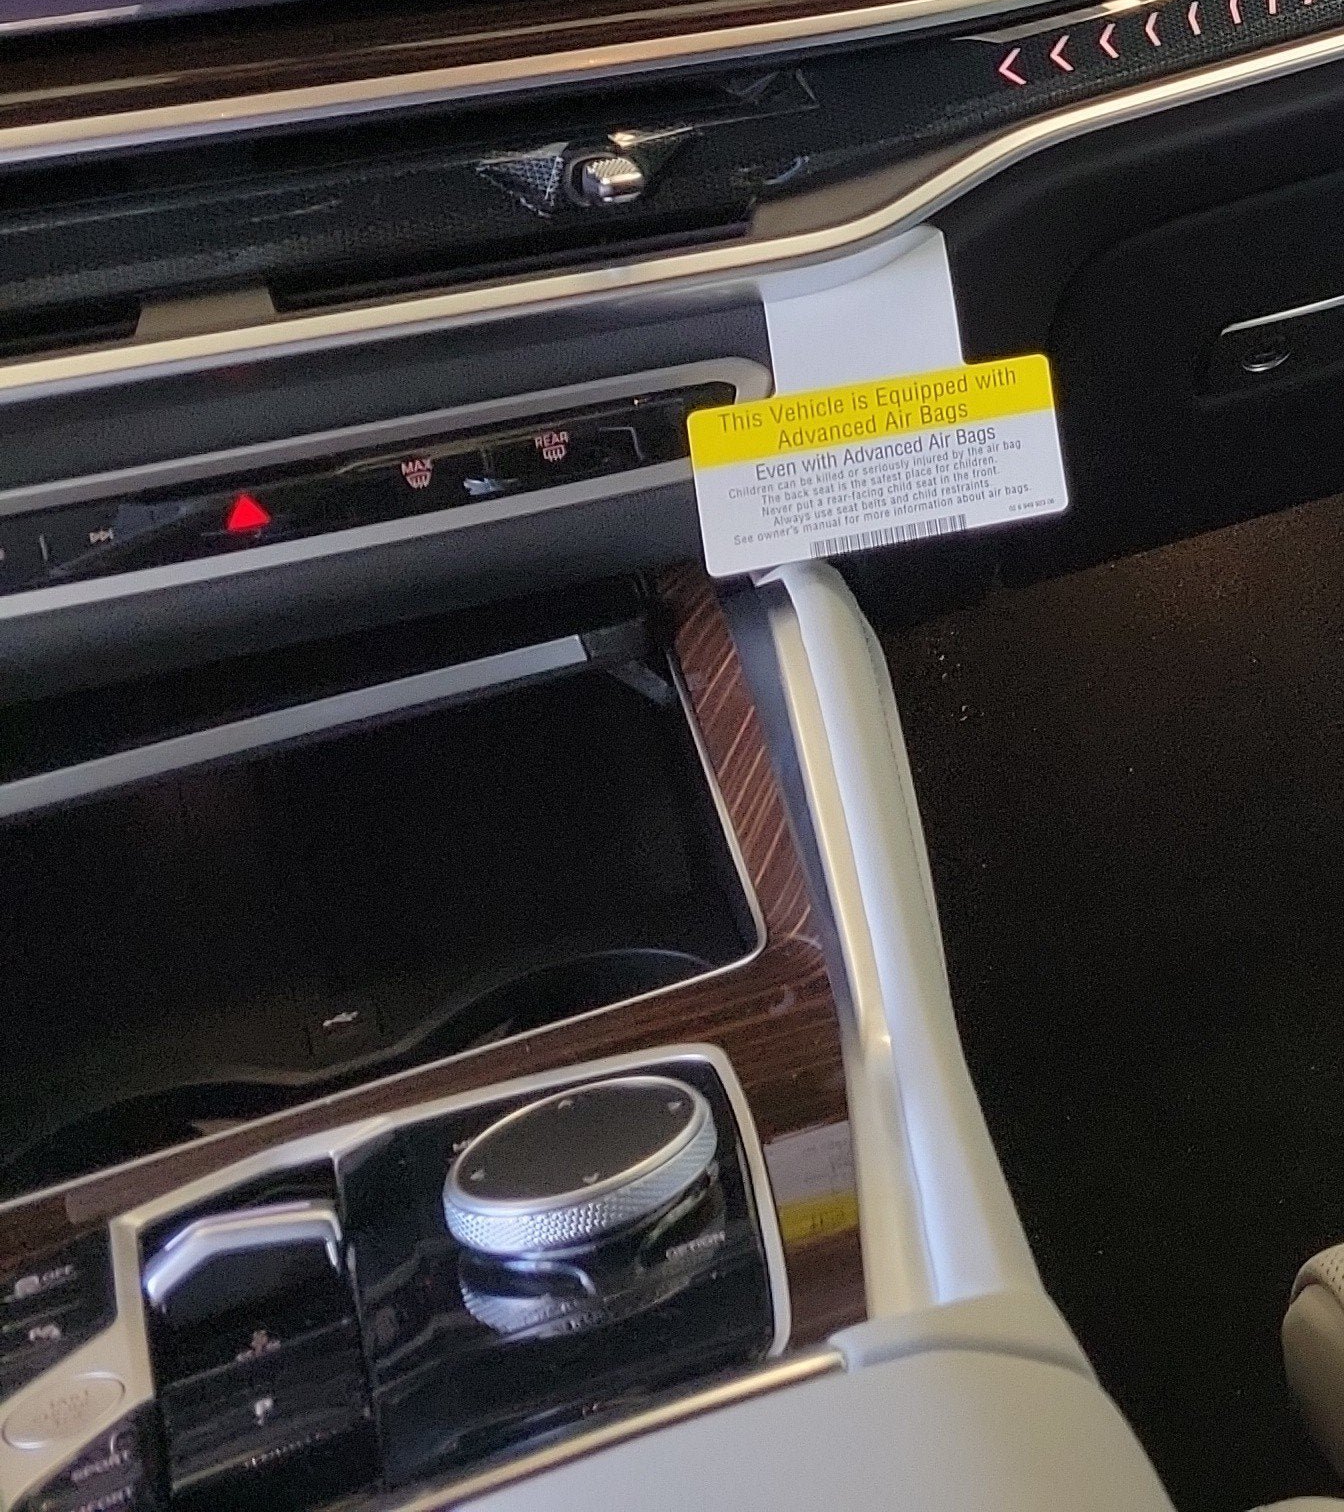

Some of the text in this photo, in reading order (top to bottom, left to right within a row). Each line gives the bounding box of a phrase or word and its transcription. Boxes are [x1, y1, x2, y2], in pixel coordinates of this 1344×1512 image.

[718, 367, 1016, 433] This Vehicle is Equipped with
[535, 431, 569, 449] REAR
[778, 403, 968, 449] Advanced Air Bags
[401, 458, 433, 475] MAX
[729, 440, 1021, 500] Children can be killed or seriously injured by the air bag
[756, 427, 996, 481] Even with Advanced Air Bags
[762, 455, 998, 505] The back seat is the safest place for children.
[762, 505, 793, 517] Never
[796, 500, 814, 512] put
[827, 487, 884, 507] rear-facing
[887, 478, 912, 493] child
[916, 477, 937, 488] seat
[940, 475, 950, 485] in
[954, 471, 973, 482] the
[734, 483, 1032, 545] See owner's manual for more information about air bags.
[774, 512, 811, 526] Always
[814, 508, 833, 519] use
[836, 503, 857, 514] seat
[862, 498, 887, 510] belts
[890, 494, 909, 505] and
[912, 488, 937, 501] child
